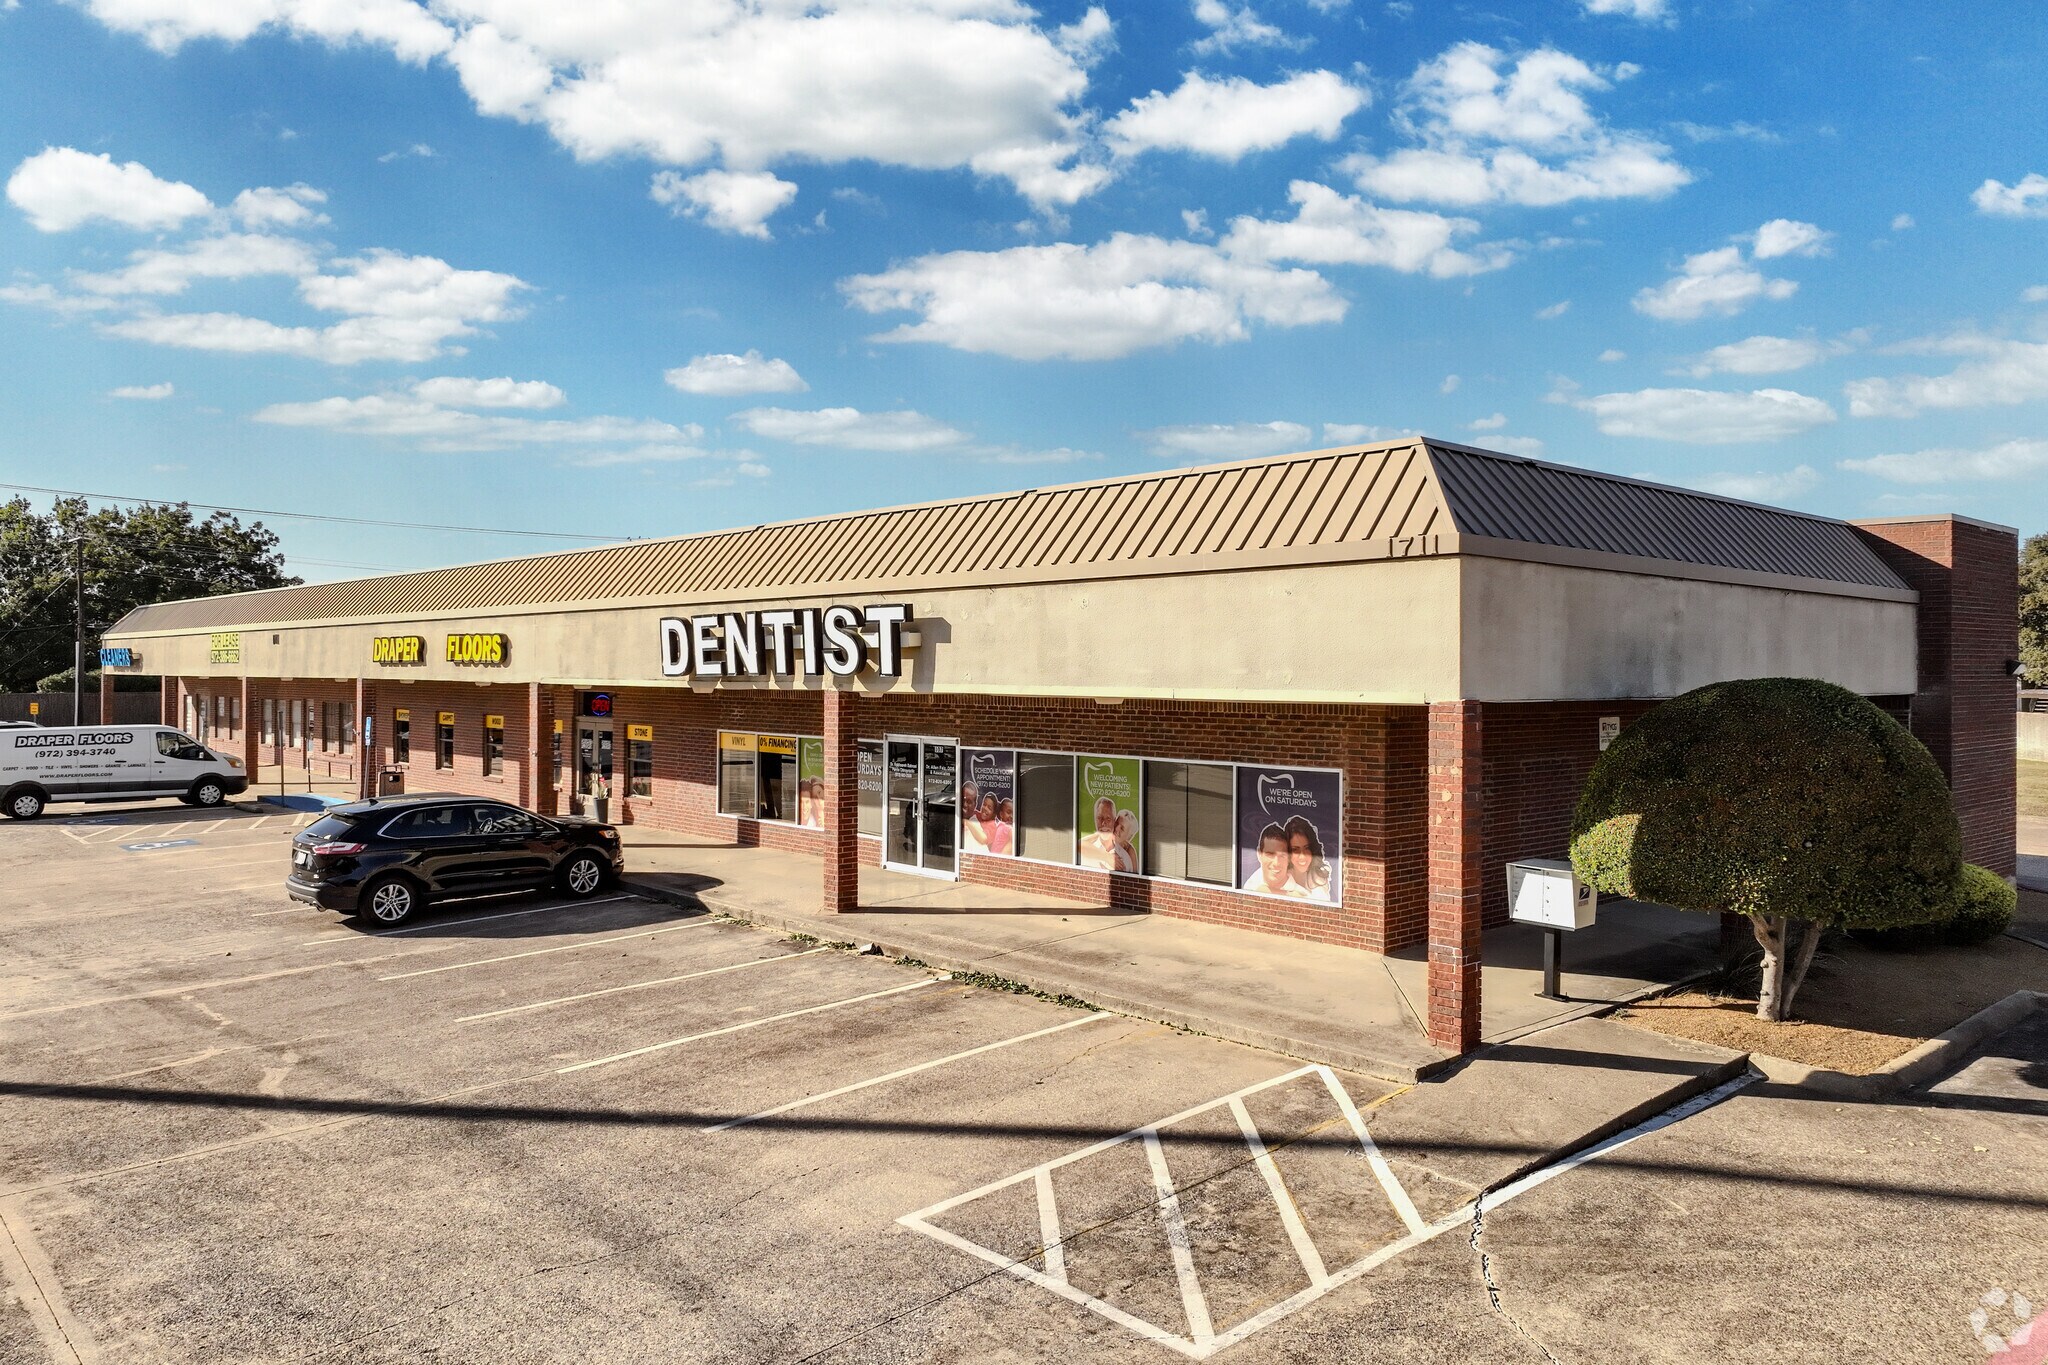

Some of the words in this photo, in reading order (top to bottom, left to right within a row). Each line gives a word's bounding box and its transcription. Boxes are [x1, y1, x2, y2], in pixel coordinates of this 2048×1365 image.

[1386, 534, 1439, 558] 1711
[211, 634, 221, 648] FOR
[222, 633, 239, 647] LEASE
[659, 604, 908, 677] DENTIST
[373, 636, 421, 662] DRAPER
[446, 634, 503, 663] FLOORS
[100, 648, 132, 667] CLEANERS
[591, 699, 610, 711] OPEN
[634, 728, 648, 737] STONE
[15, 735, 75, 748] DRAPER
[78, 732, 133, 745] FLOORS
[731, 736, 746, 746] VINYL
[759, 737, 768, 747] 0%
[768, 738, 797, 749] FINANCING
[35, 750, 64, 758] (972)
[66, 748, 116, 757] 394-3740
[974, 767, 998, 775] SCHEDULE
[1093, 774, 1128, 783] WELCOMING
[857, 779, 883, 792] 820-6200
[1091, 788, 1104, 796] (972)
[1104, 789, 1131, 798] 820-6200
[1269, 788, 1292, 797] WE'RE
[1292, 790, 1313, 799] OPEN
[1264, 796, 1276, 804] ON
[1276, 797, 1318, 808] SATURDAYS
